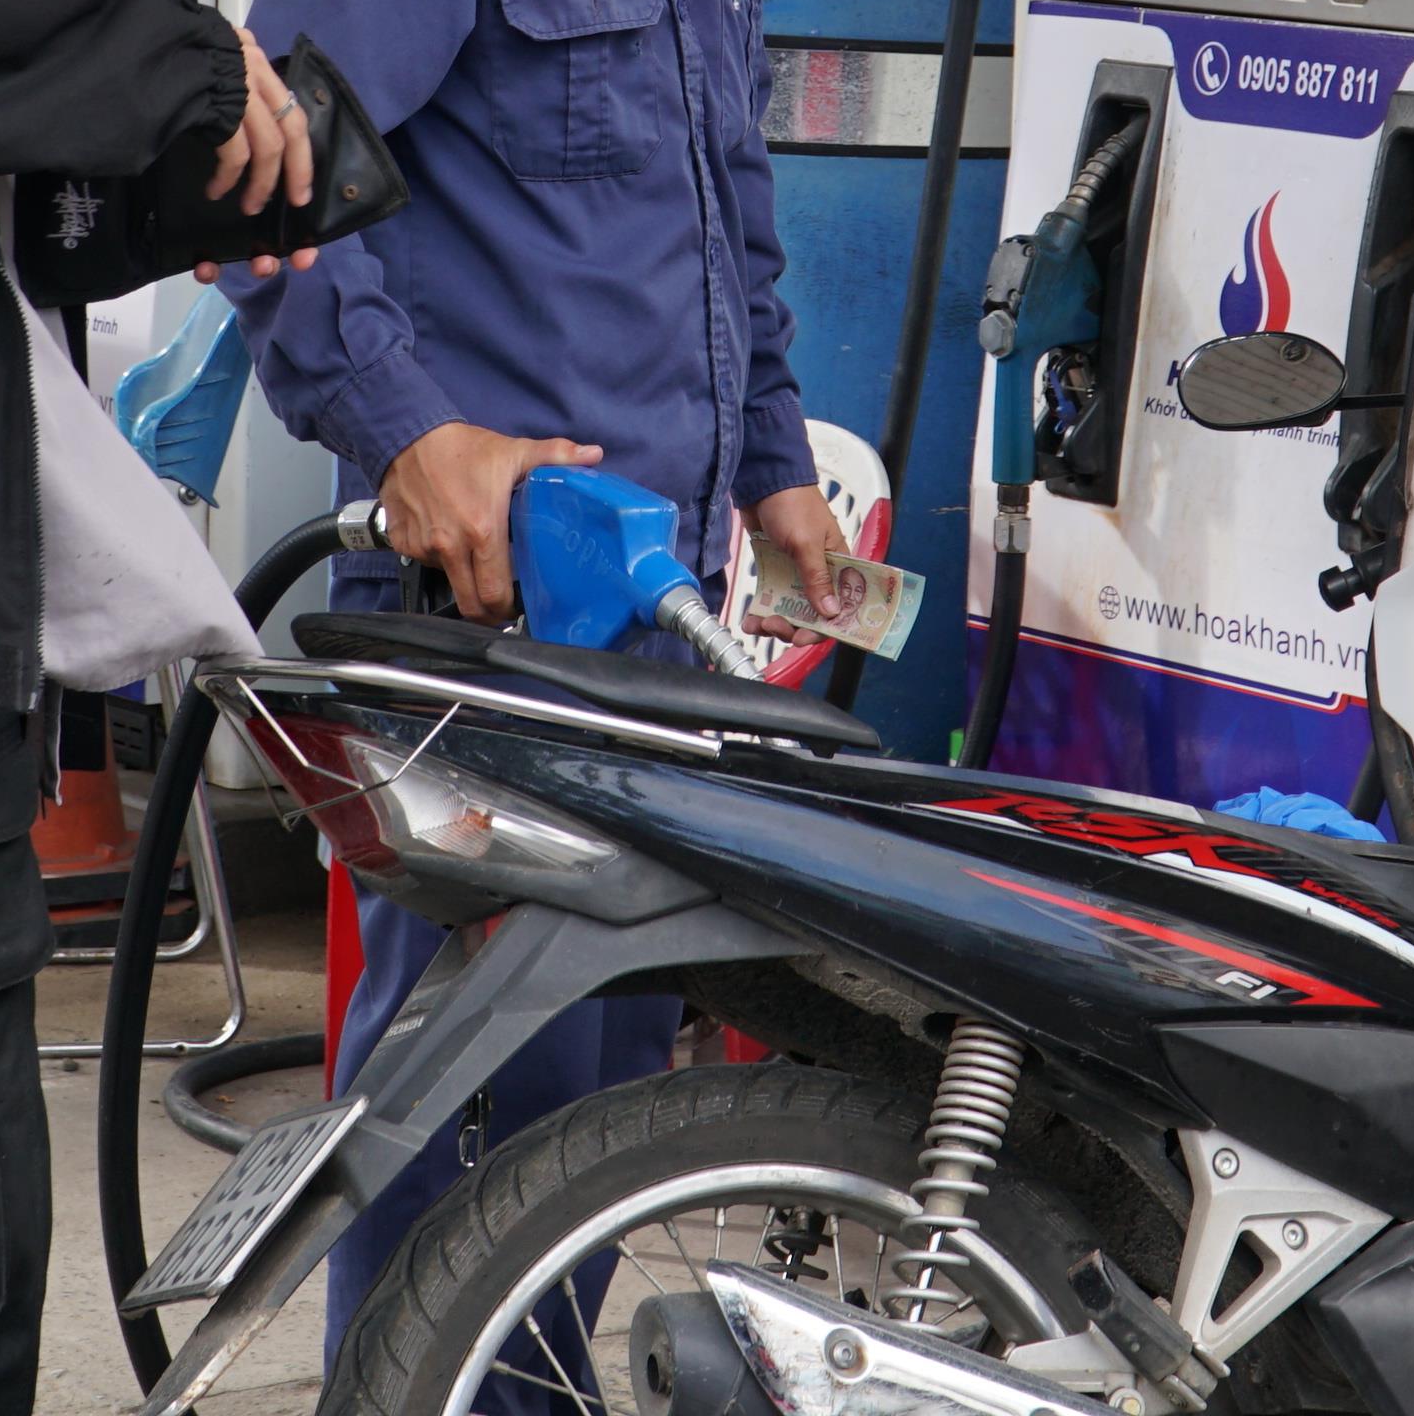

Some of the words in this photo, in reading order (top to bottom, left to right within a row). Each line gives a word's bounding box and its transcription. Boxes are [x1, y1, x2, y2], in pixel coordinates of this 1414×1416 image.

[1238, 54, 1291, 93] 0905
[1296, 60, 1336, 98] 887
[1340, 67, 1379, 104] 811
[1144, 397, 1178, 418] Khởi
[1124, 594, 1368, 673] www.hoakhanh.vn
[1215, 971, 1277, 1000] FI
